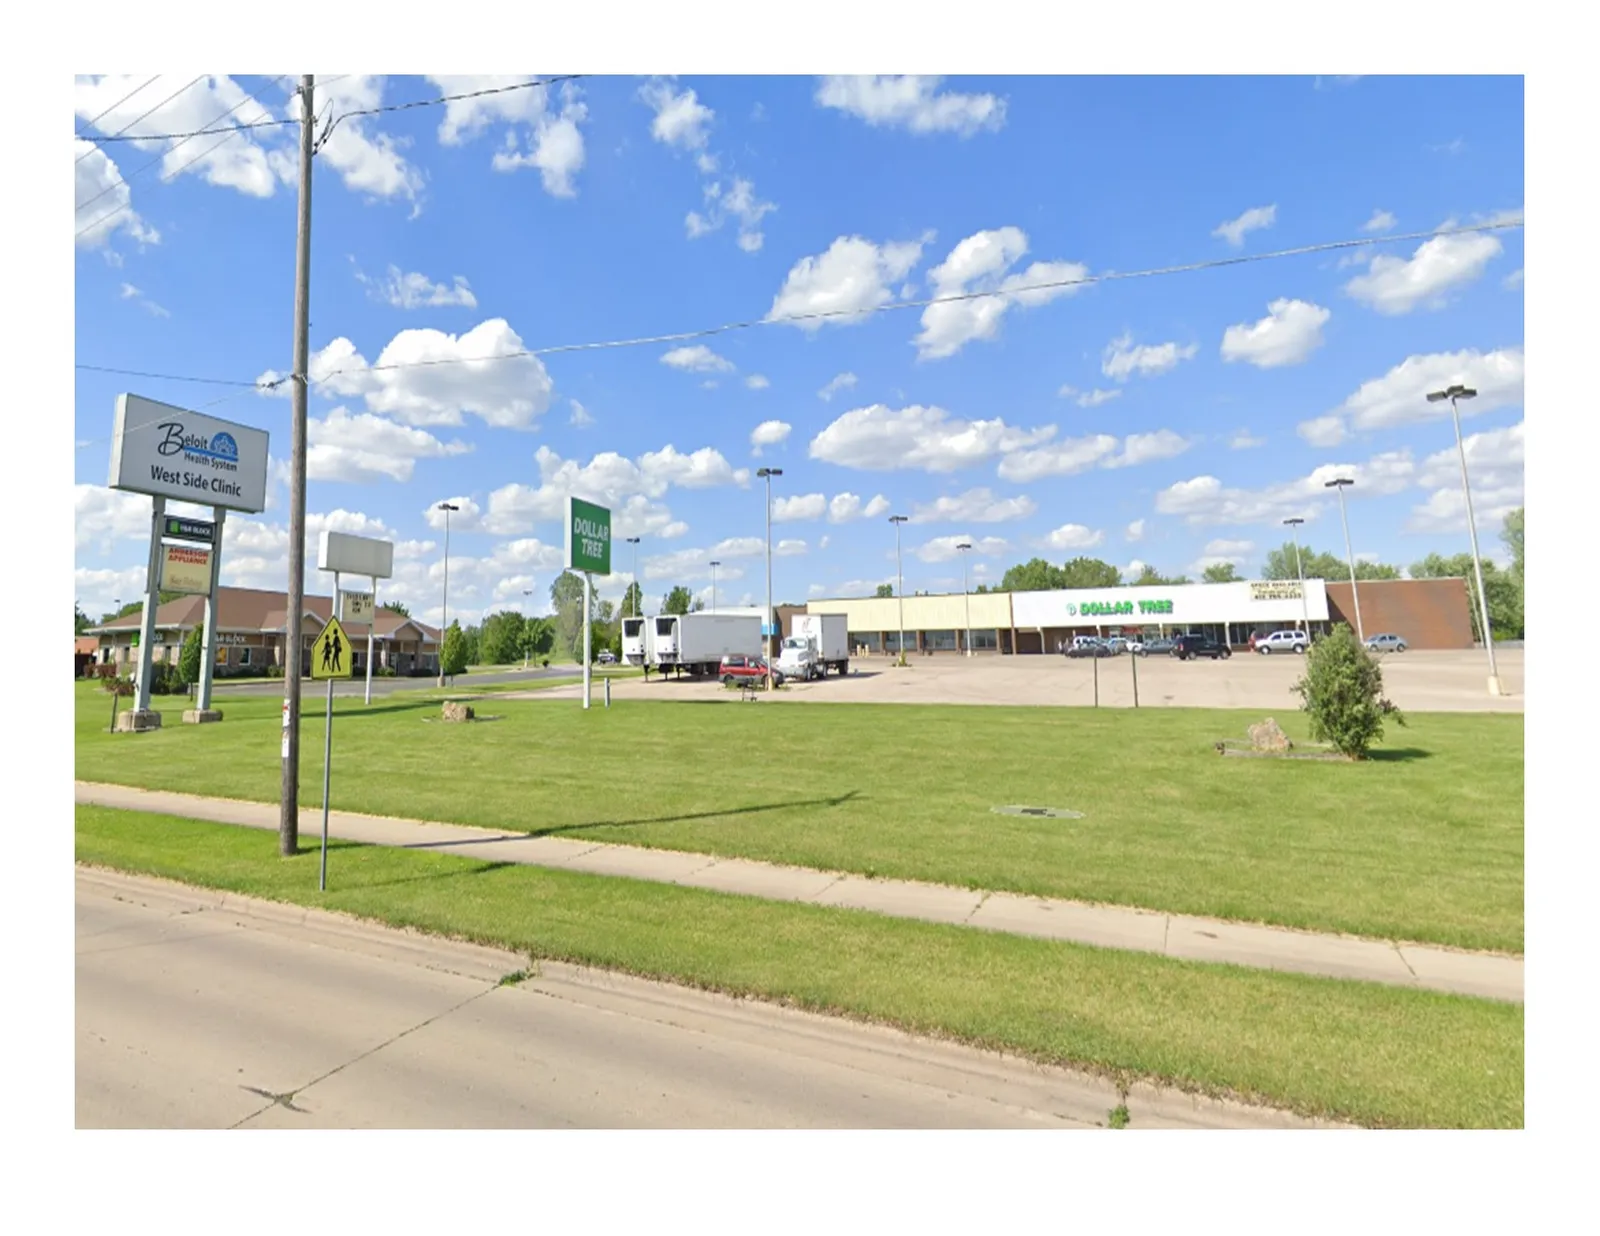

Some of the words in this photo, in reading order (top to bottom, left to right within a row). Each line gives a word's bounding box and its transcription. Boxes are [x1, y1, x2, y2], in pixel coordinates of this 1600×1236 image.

[157, 422, 209, 456] Beloit
[184, 451, 210, 466] Health
[211, 456, 238, 472] System
[150, 464, 181, 485] West
[183, 471, 209, 490] Side
[210, 477, 242, 497] Clinic
[193, 526, 211, 535] BLOCK
[574, 516, 610, 542] DOLLAR
[168, 547, 209, 558] ANDERSON
[581, 538, 604, 559] TREE
[168, 554, 207, 566] APPLIANCE
[1079, 601, 1134, 617] DOLLAR
[1137, 599, 1174, 615] TREE
